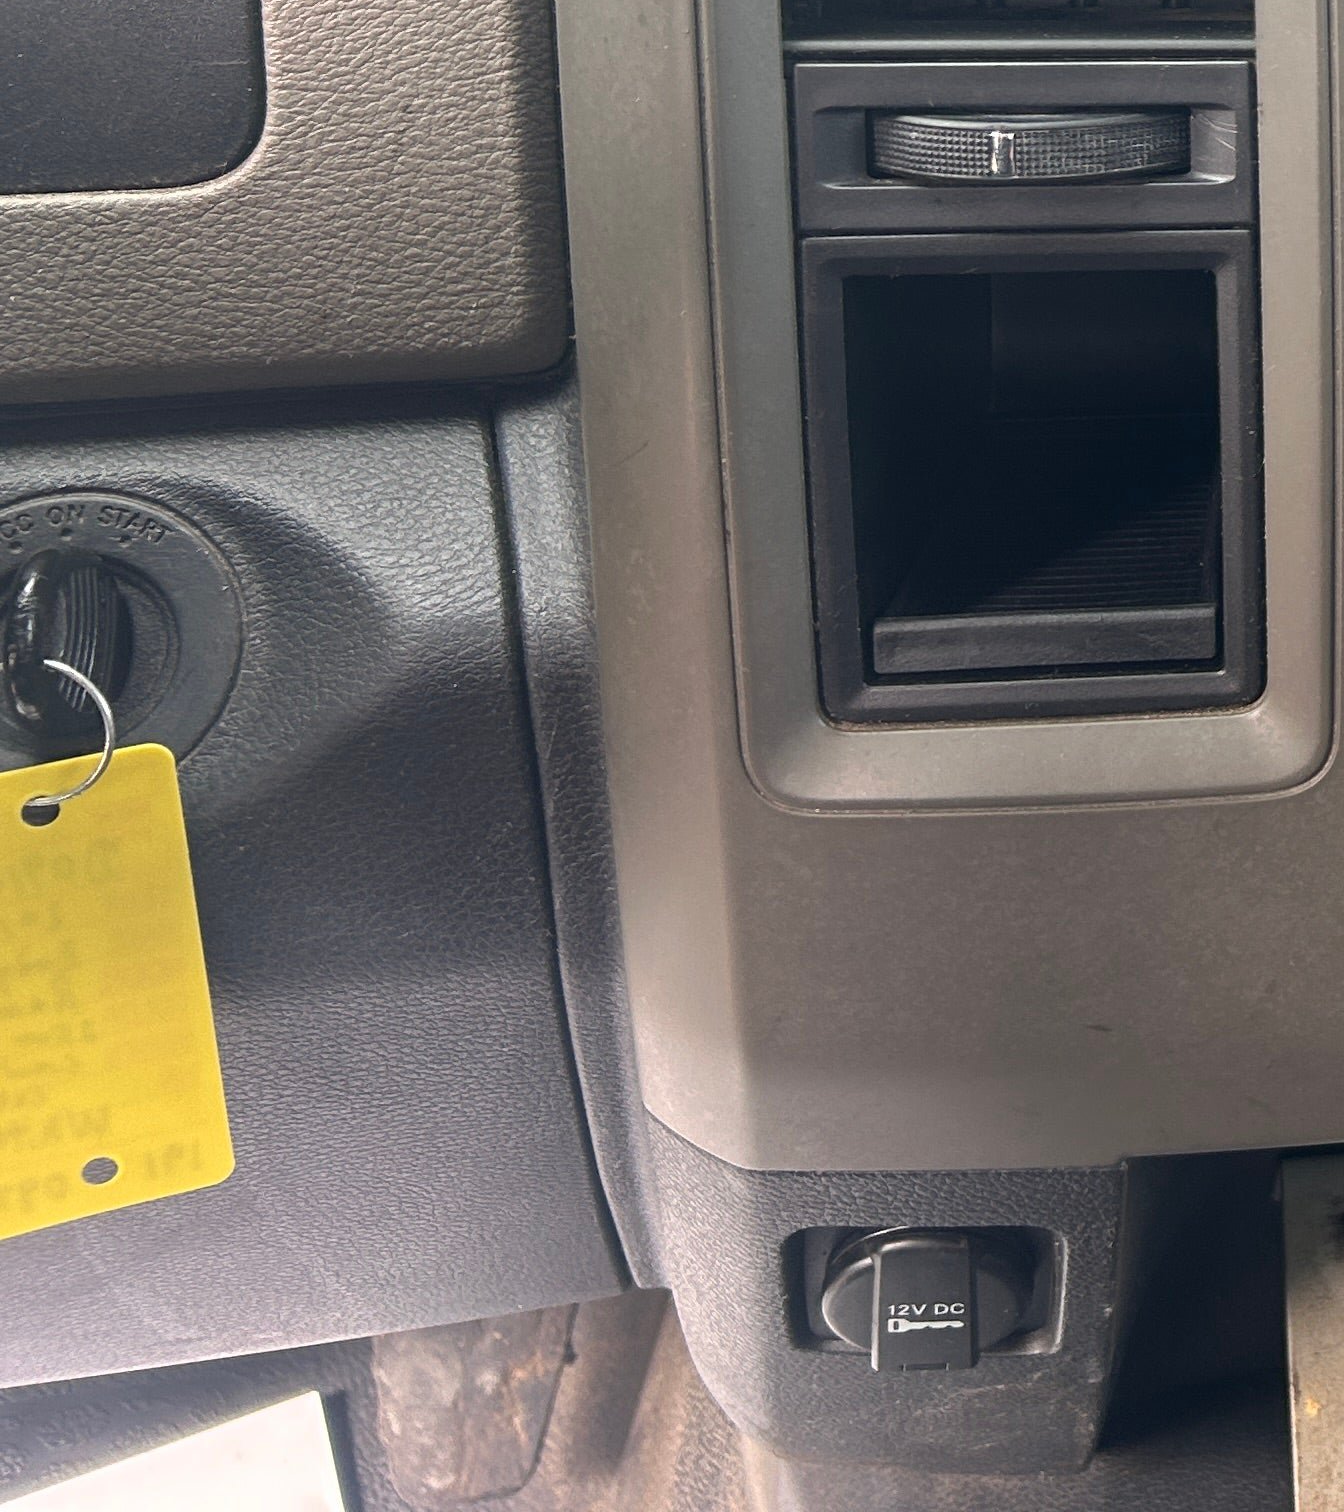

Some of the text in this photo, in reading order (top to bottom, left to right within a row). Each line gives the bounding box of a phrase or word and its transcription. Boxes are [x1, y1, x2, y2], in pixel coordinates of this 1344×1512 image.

[97, 505, 174, 543] START
[889, 1303, 964, 1315] 12V DC
